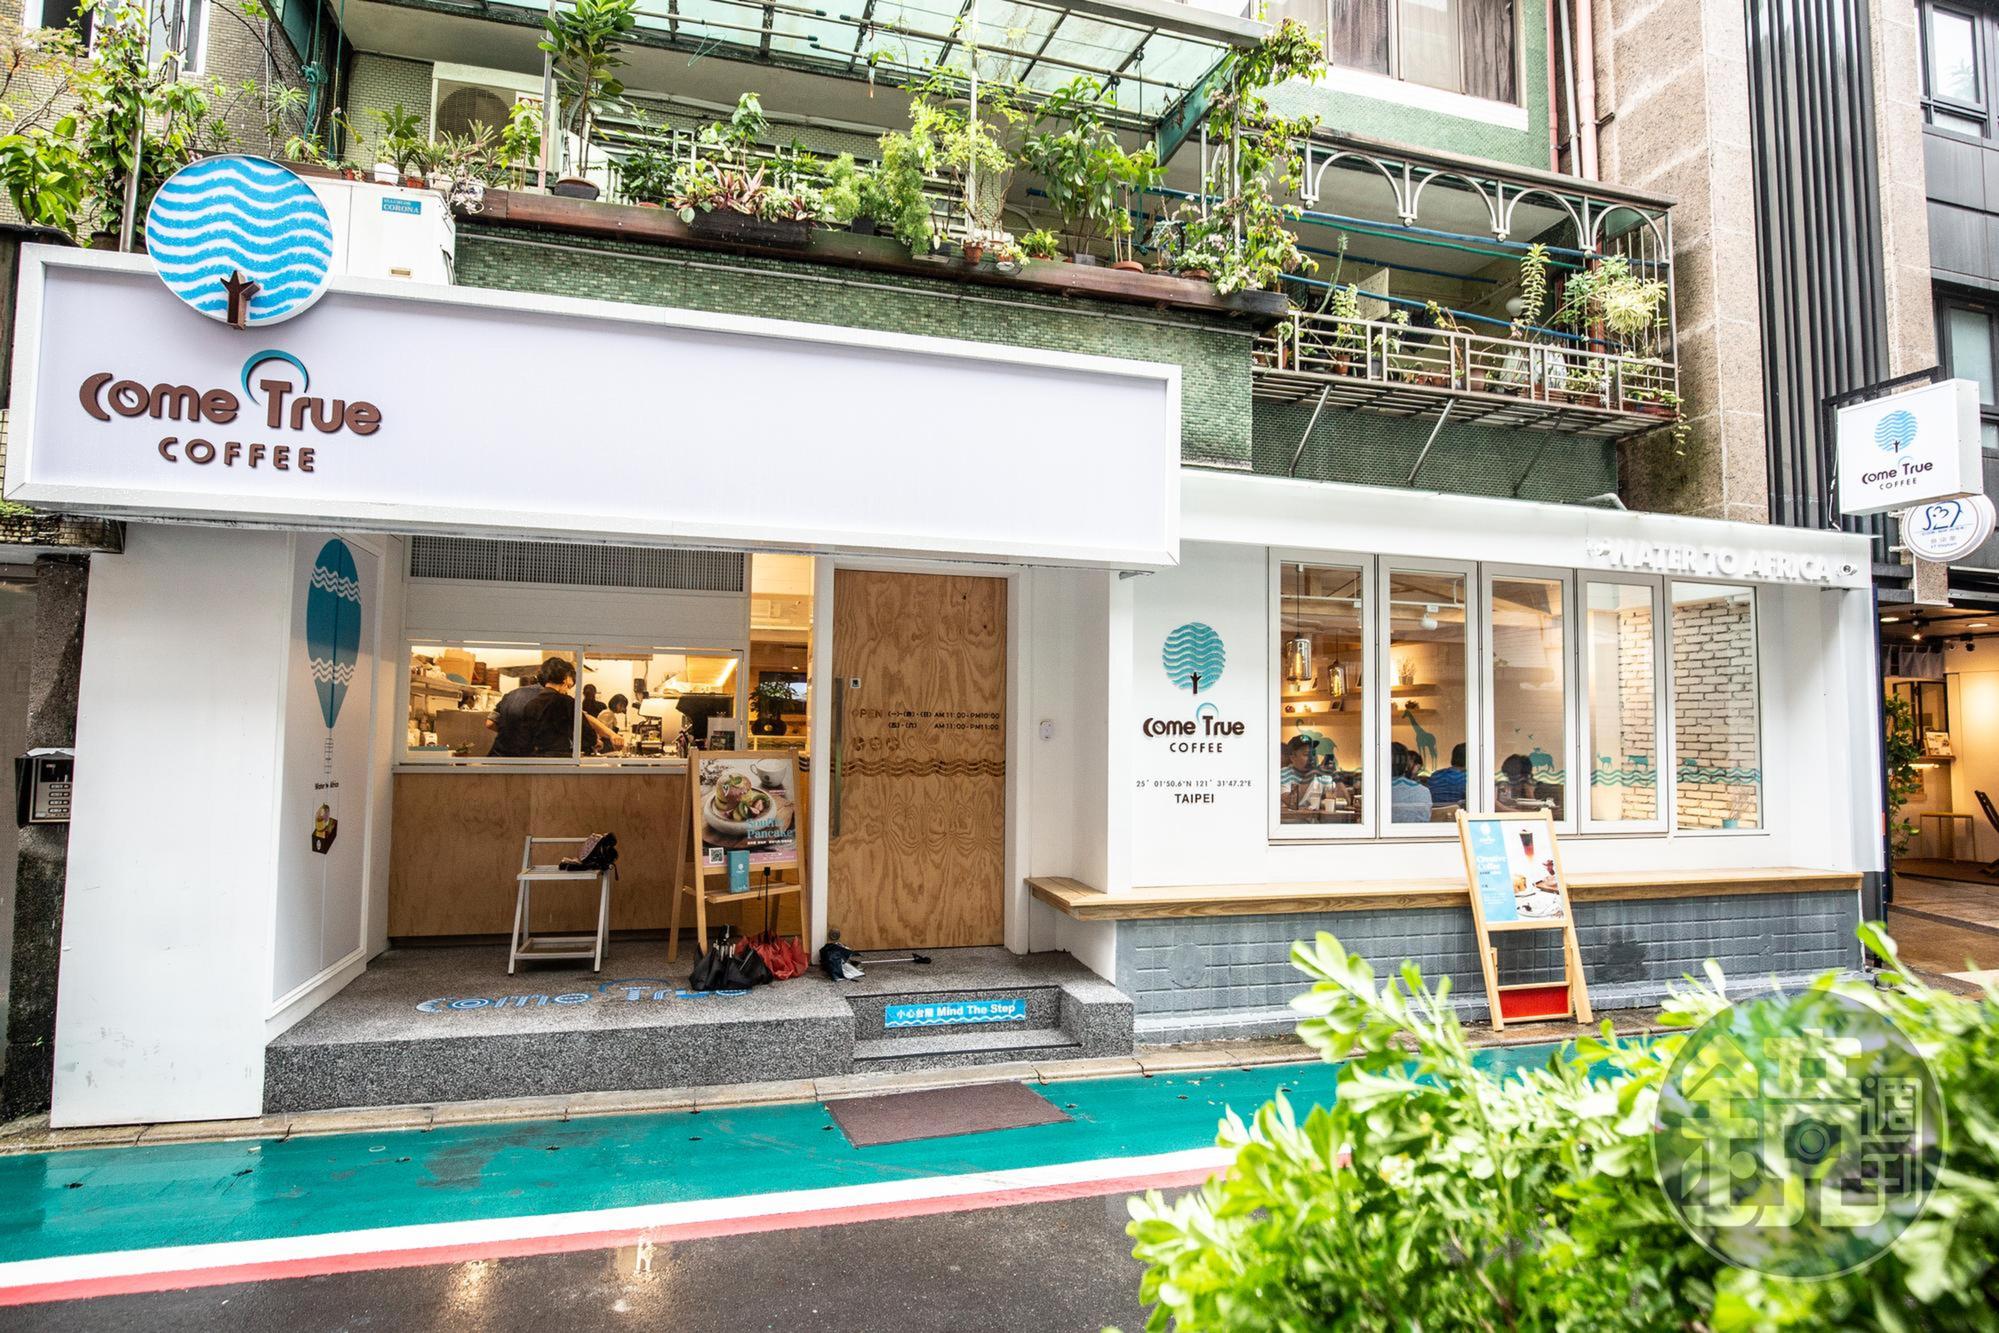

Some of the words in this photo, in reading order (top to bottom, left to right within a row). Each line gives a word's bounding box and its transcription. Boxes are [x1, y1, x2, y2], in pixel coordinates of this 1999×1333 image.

[79, 371, 240, 425] Come
[259, 378, 383, 436] True
[157, 436, 315, 472] COFFEE
[1861, 469, 1898, 484] Come
[1902, 462, 1933, 475] True
[1879, 477, 1917, 490] COFFEE
[1743, 548, 1831, 584] AFRICA
[851, 708, 883, 719] OPEN
[1142, 717, 1197, 738] Come
[1202, 715, 1245, 736] True
[1169, 742, 1223, 753] COFFEE
[1174, 793, 1215, 804] TAIPEI
[747, 828, 794, 839] Pancake
[937, 1006, 963, 1017] Mind
[967, 1005, 987, 1015] The
[990, 1003, 1016, 1015] Step
